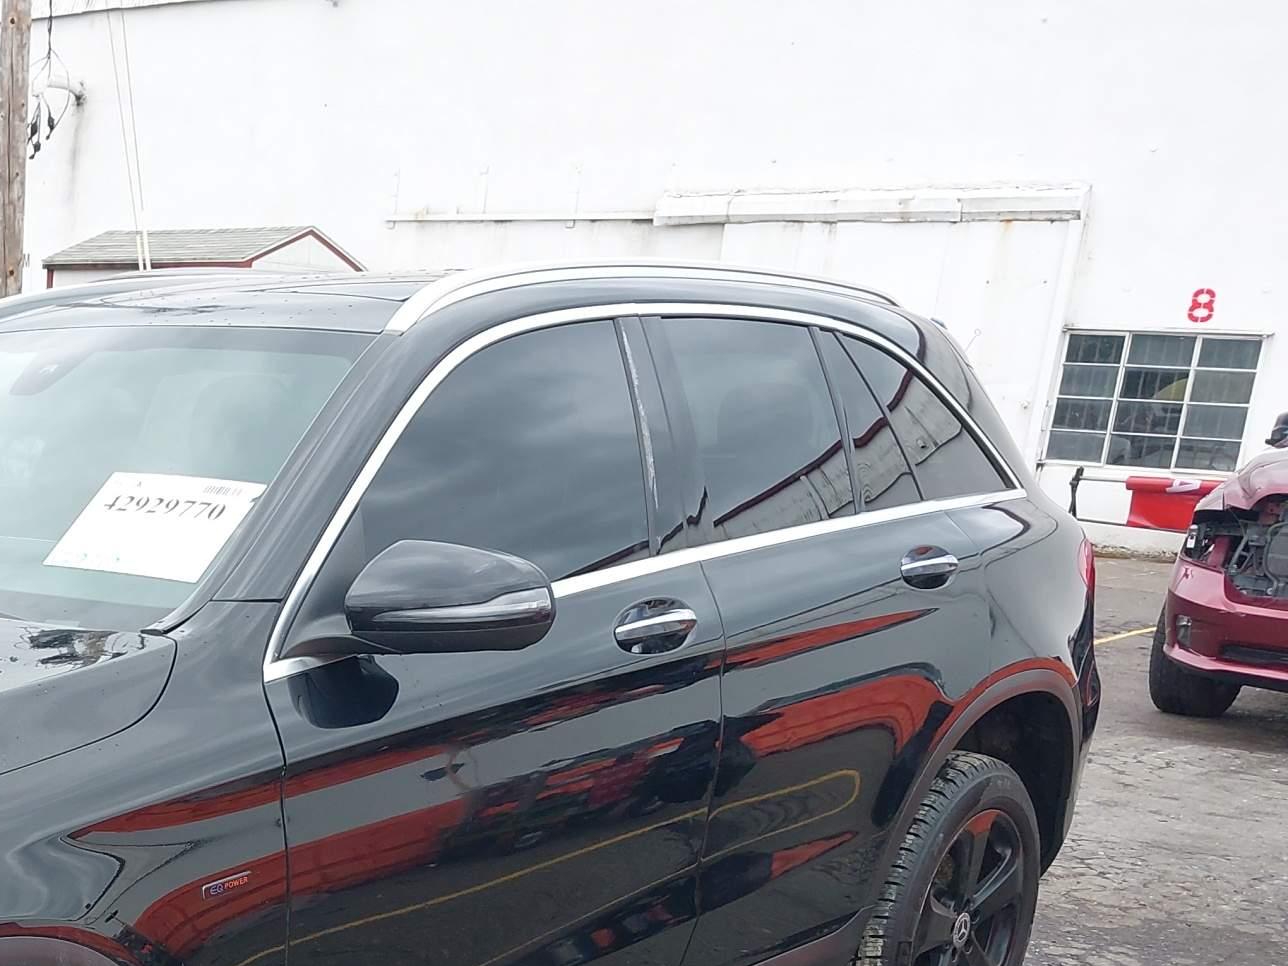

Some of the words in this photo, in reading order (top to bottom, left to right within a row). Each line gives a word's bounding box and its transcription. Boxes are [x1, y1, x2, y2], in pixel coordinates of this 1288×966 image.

[1187, 288, 1216, 323] 8
[104, 495, 227, 520] 42929770
[209, 883, 224, 895] EQ
[224, 876, 249, 889] POWER
